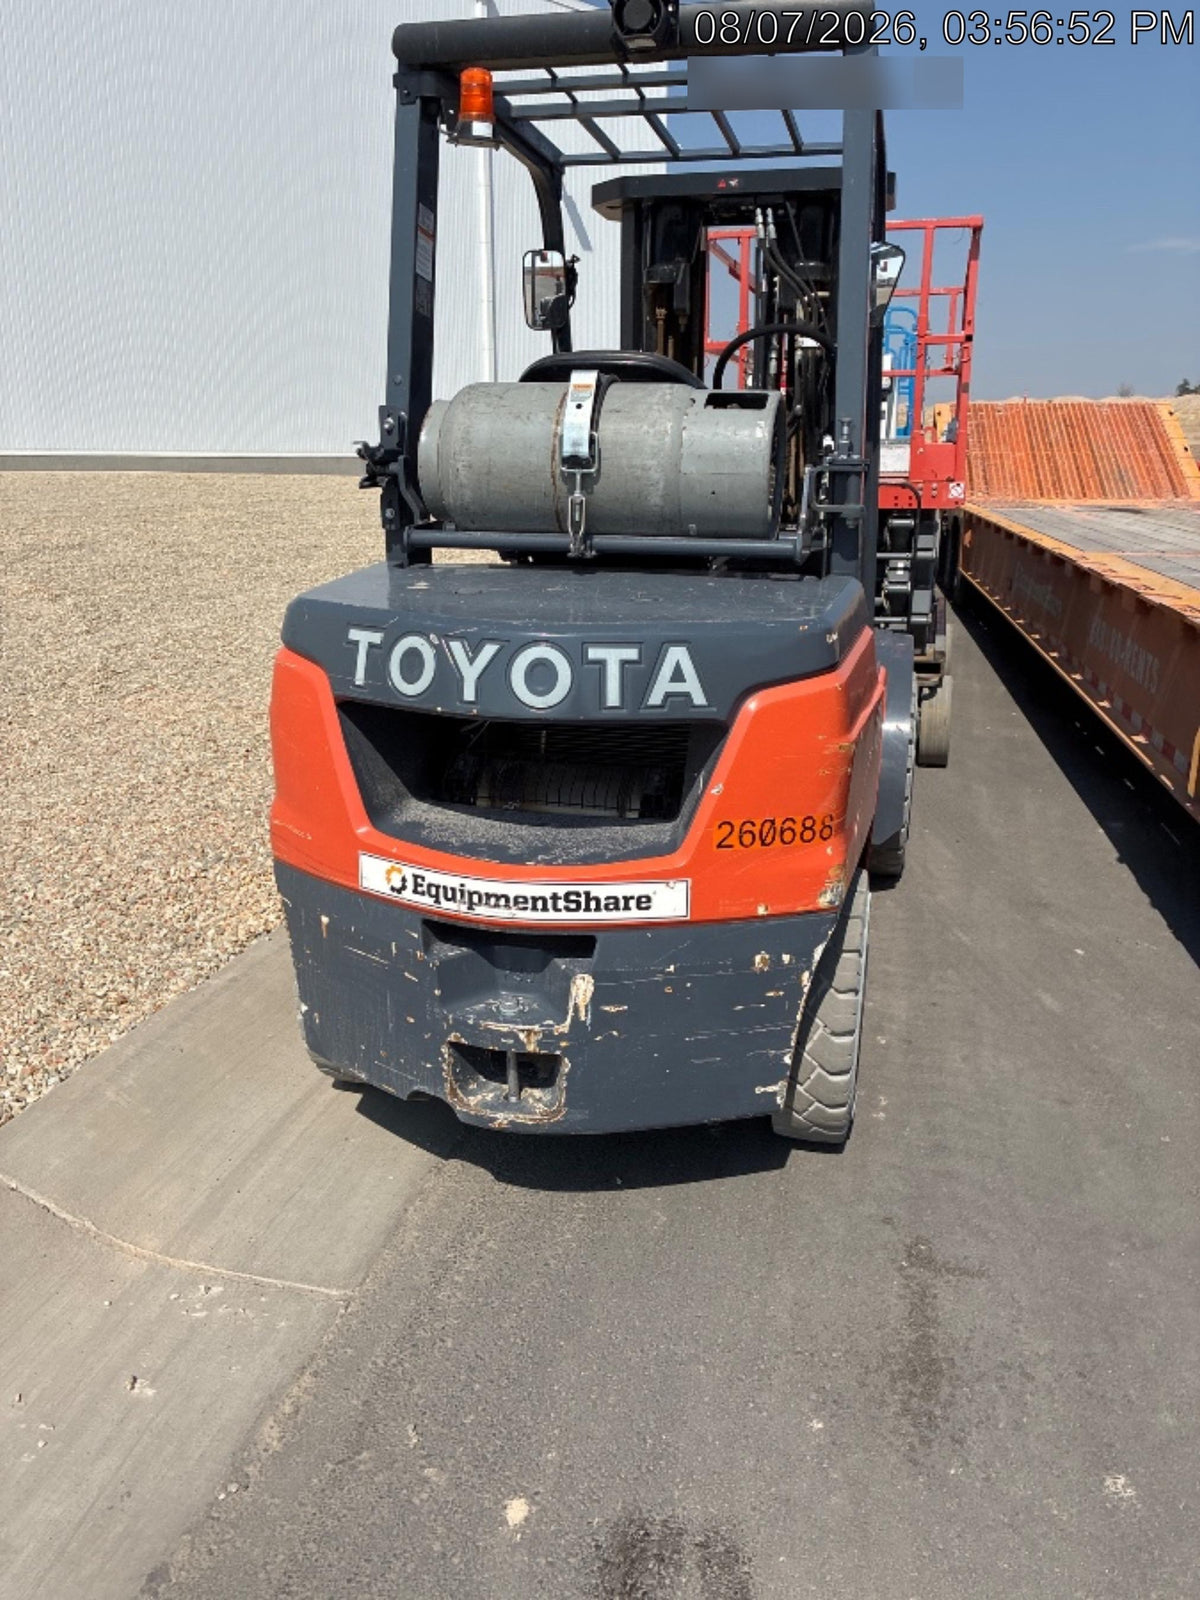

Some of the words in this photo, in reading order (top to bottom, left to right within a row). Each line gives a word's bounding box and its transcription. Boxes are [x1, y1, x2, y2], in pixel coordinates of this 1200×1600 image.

[347, 628, 709, 709] TOYOTA
[716, 814, 834, 850] 260688
[411, 873, 653, 915] EquipmentShare
